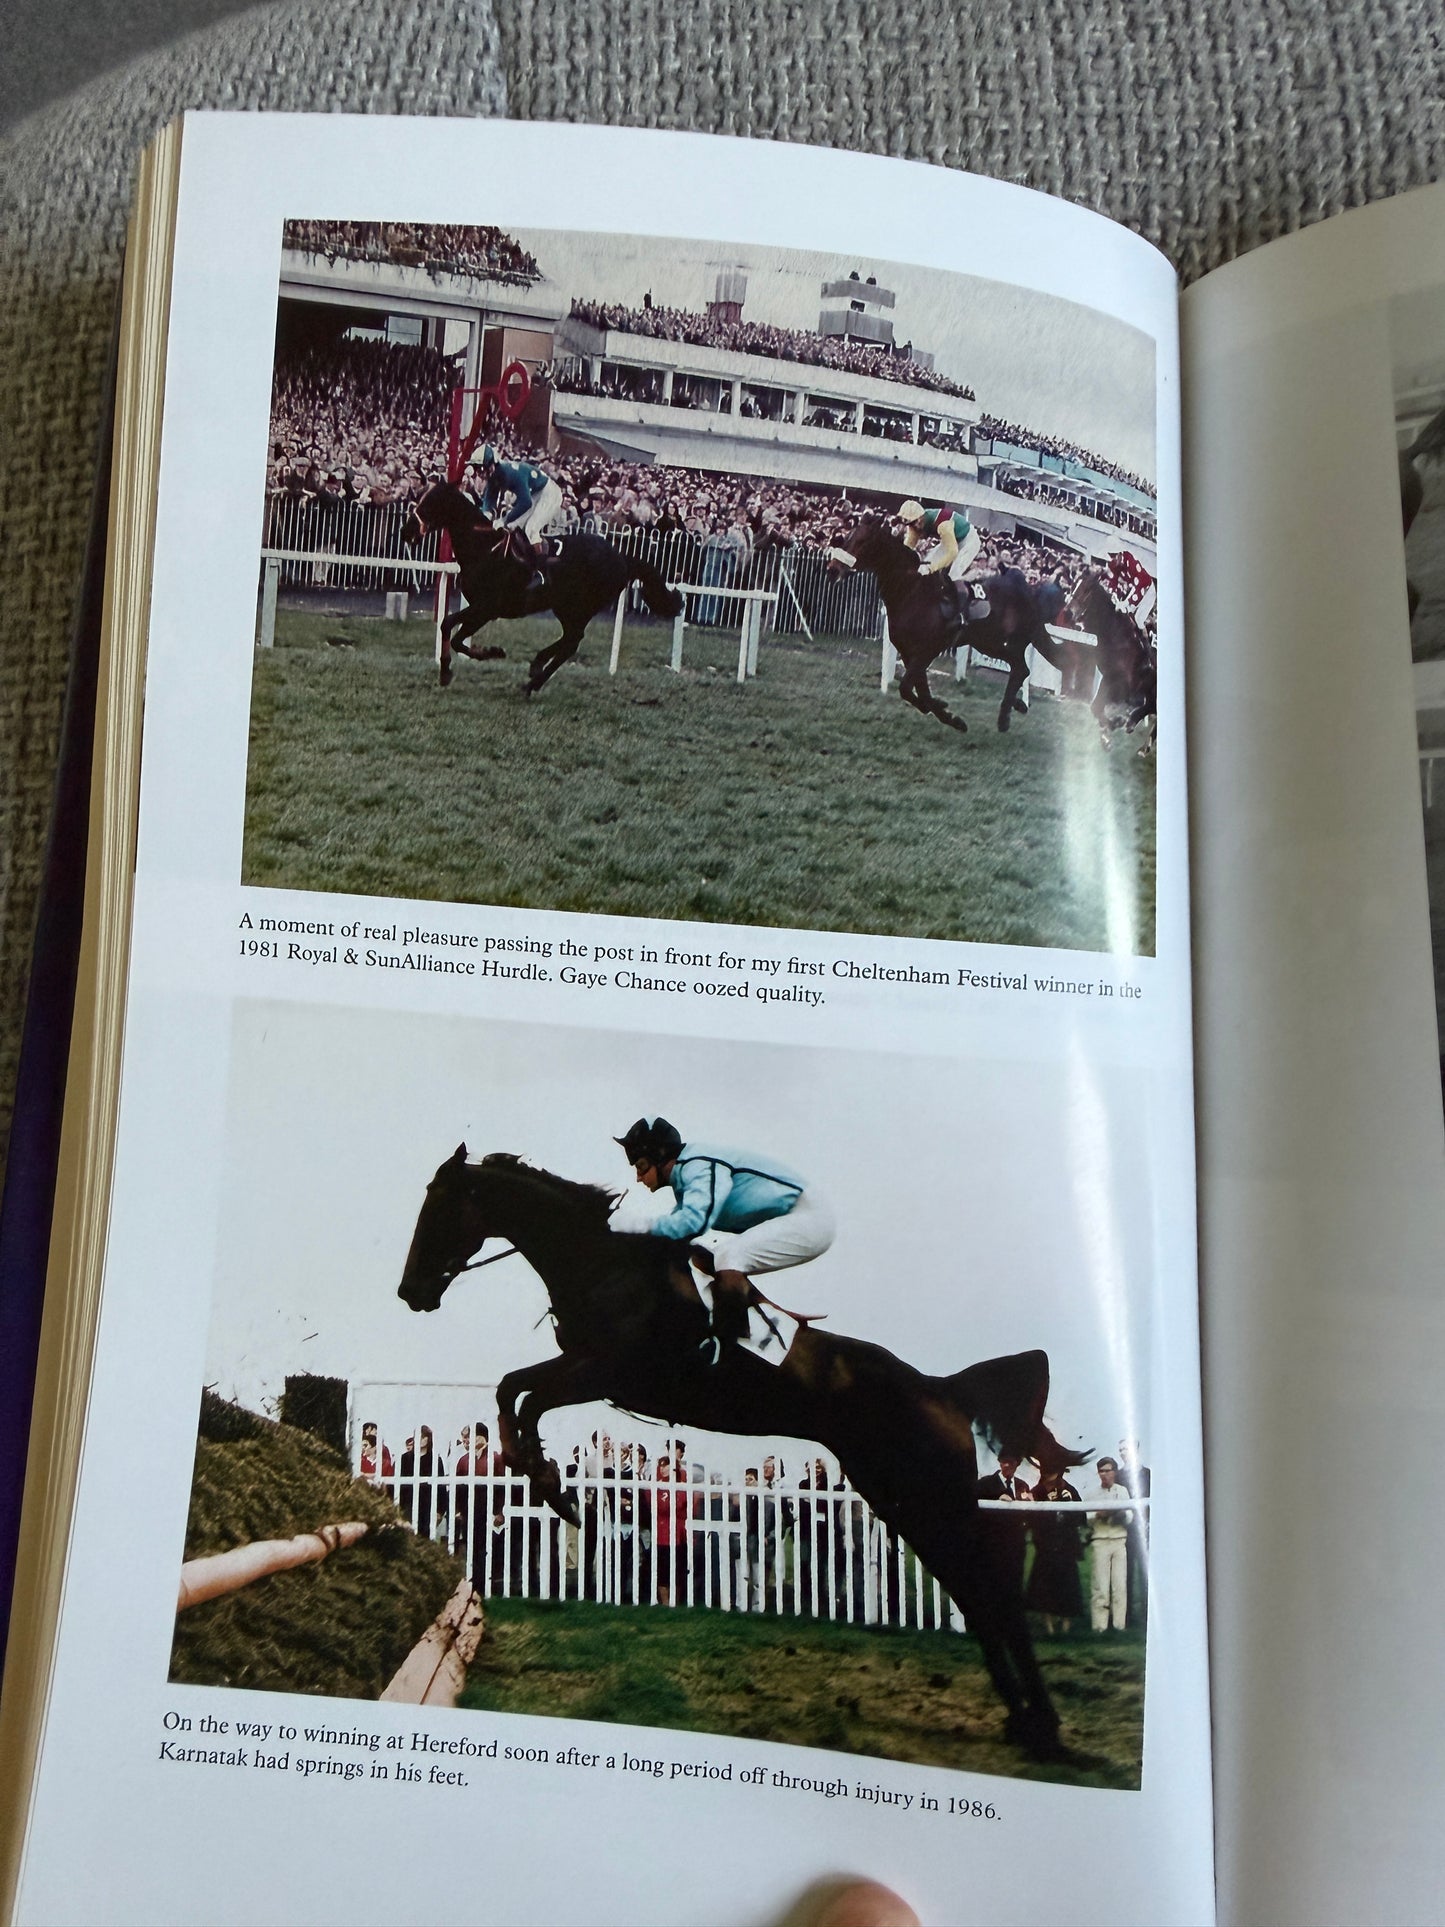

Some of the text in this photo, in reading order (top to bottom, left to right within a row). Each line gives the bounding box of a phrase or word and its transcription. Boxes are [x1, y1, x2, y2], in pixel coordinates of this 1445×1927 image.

[238, 912, 1142, 1000] A moment of real pleasure passing the post in front for my first Cheltenham Festival winner in the
[239, 939, 826, 1008] 1981 Royal & SunAlliance Hurdle. Gaye Chance oozed quality.
[158, 1741, 469, 1787] Karnatak had springs in his feet.
[162, 1711, 1002, 1821] On the way to winning at Hereford soon after a long period off through injury in 1986.
